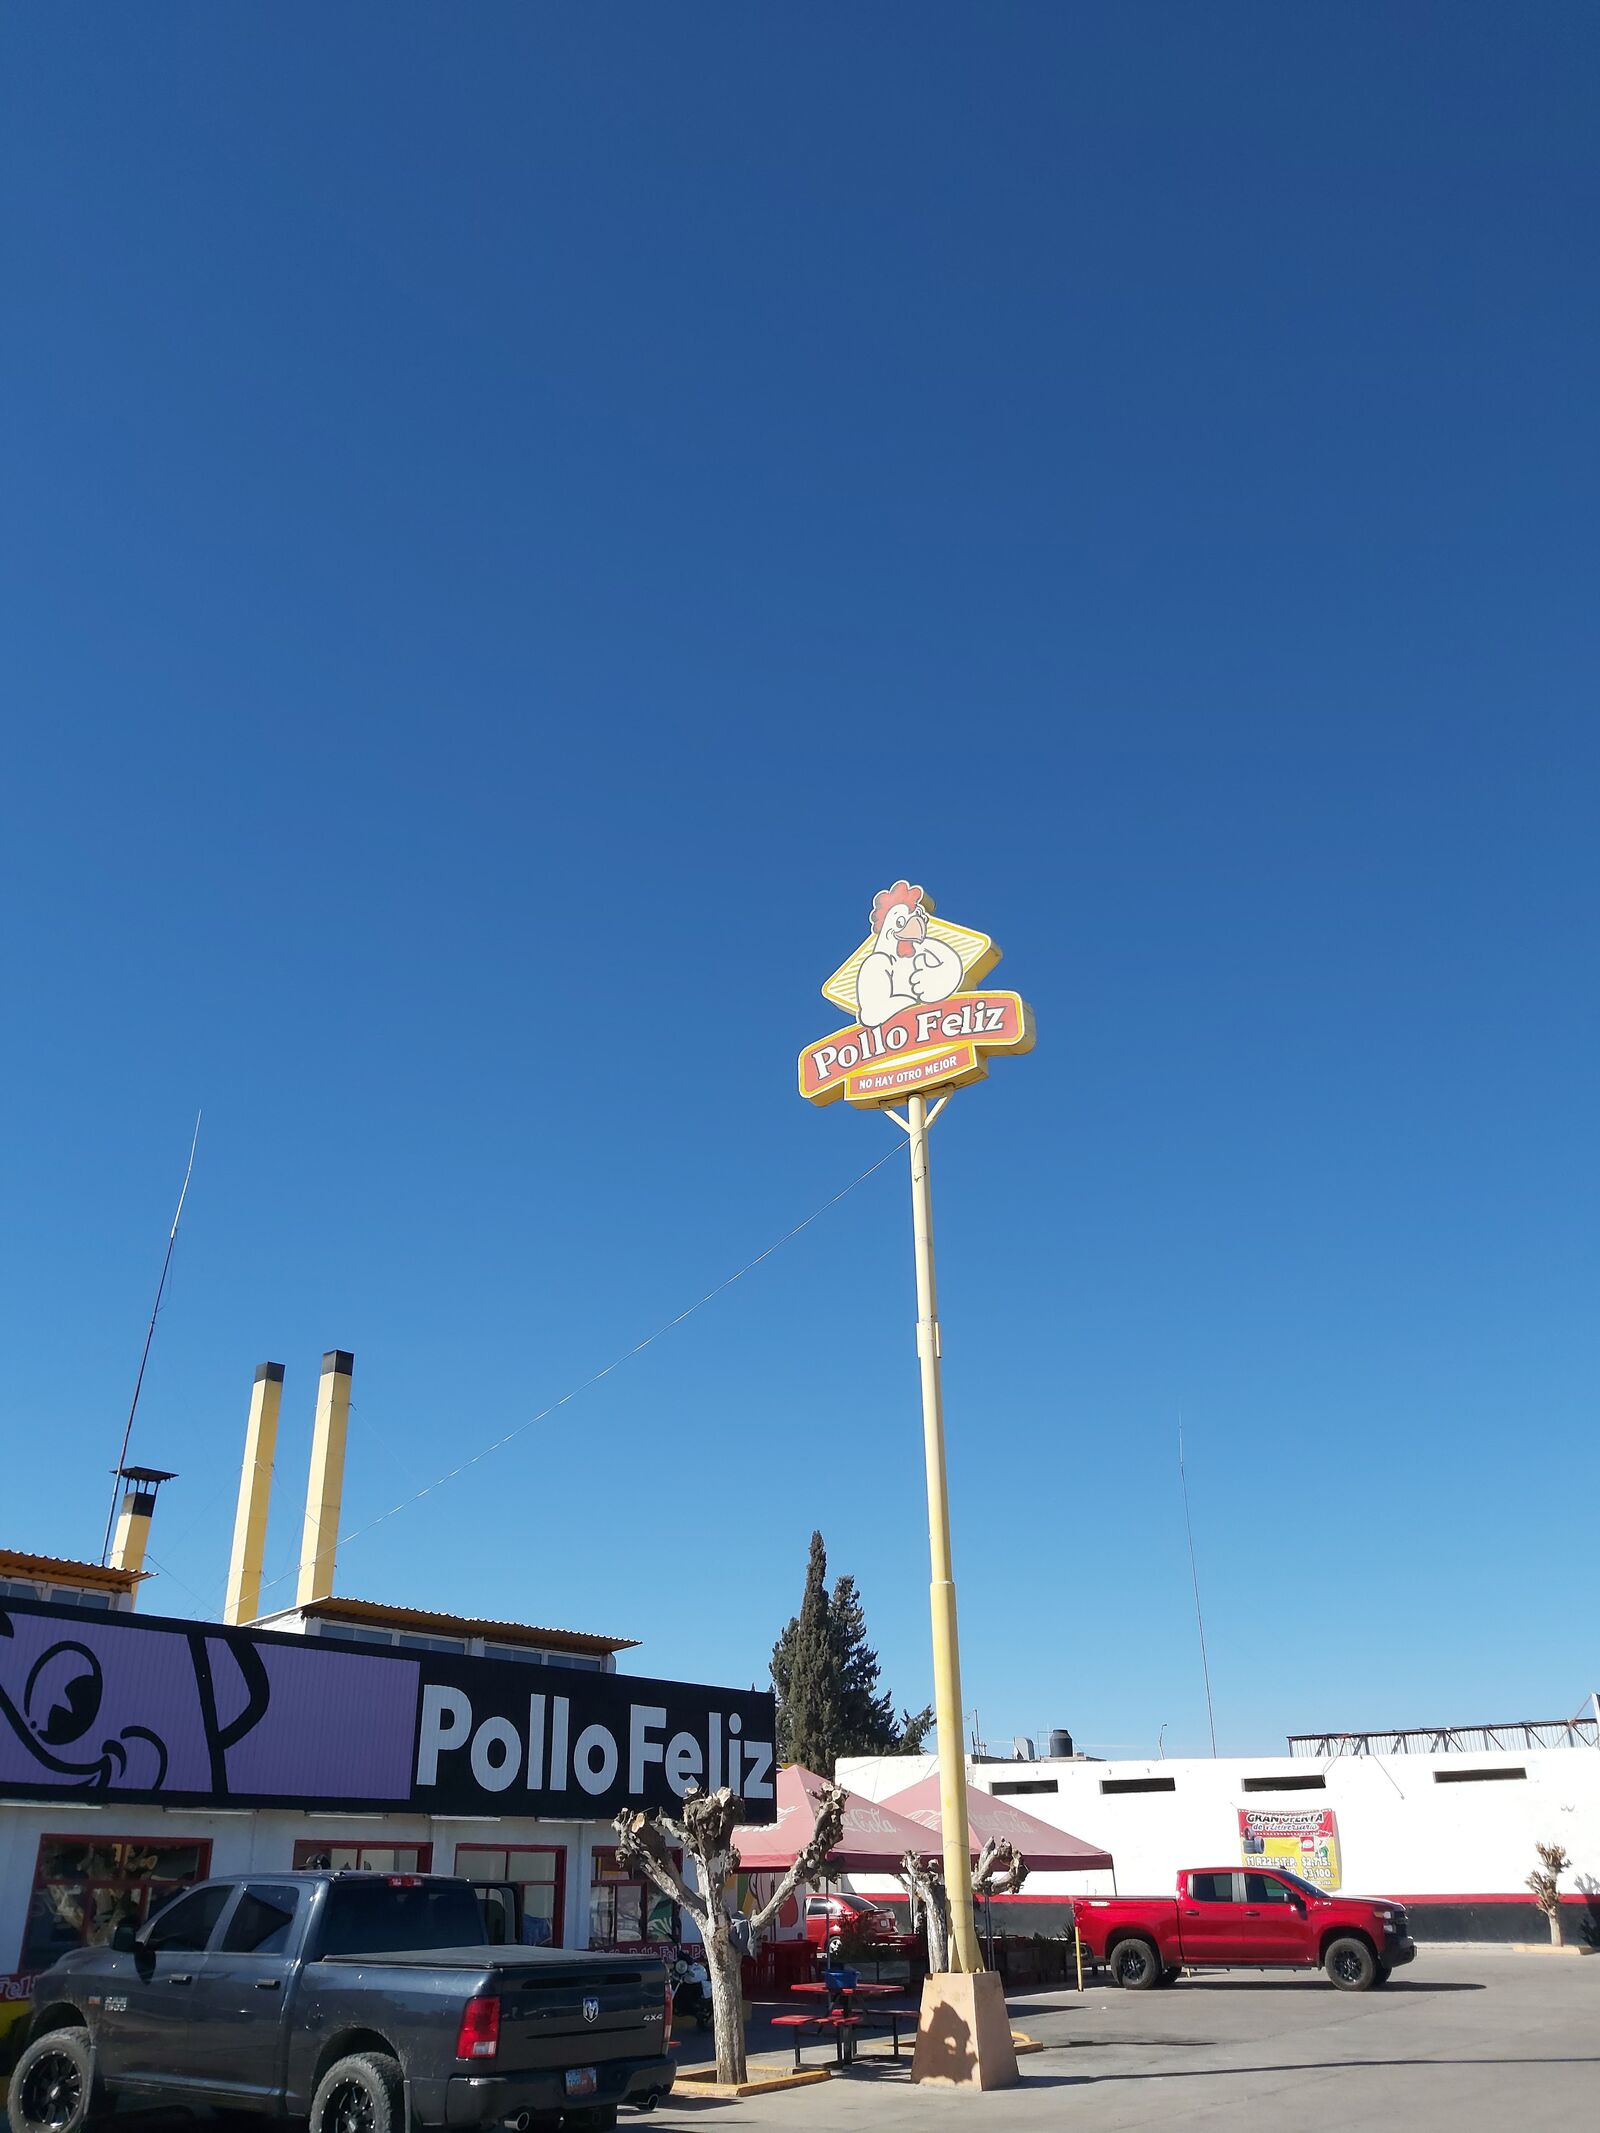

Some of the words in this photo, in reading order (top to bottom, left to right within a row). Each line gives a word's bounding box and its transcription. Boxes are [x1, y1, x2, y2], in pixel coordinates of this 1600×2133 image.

[812, 1024, 908, 1080] Pollo
[915, 1001, 1008, 1042] Feliz
[859, 1079, 873, 1090] NO
[875, 1075, 895, 1088] HAY
[896, 1068, 922, 1083] OTRO
[925, 1056, 958, 1076] MEJOR
[1247, 1812, 1280, 1823] GRAN
[1252, 1822, 1263, 1831] de
[1246, 1856, 1256, 1867] 11
